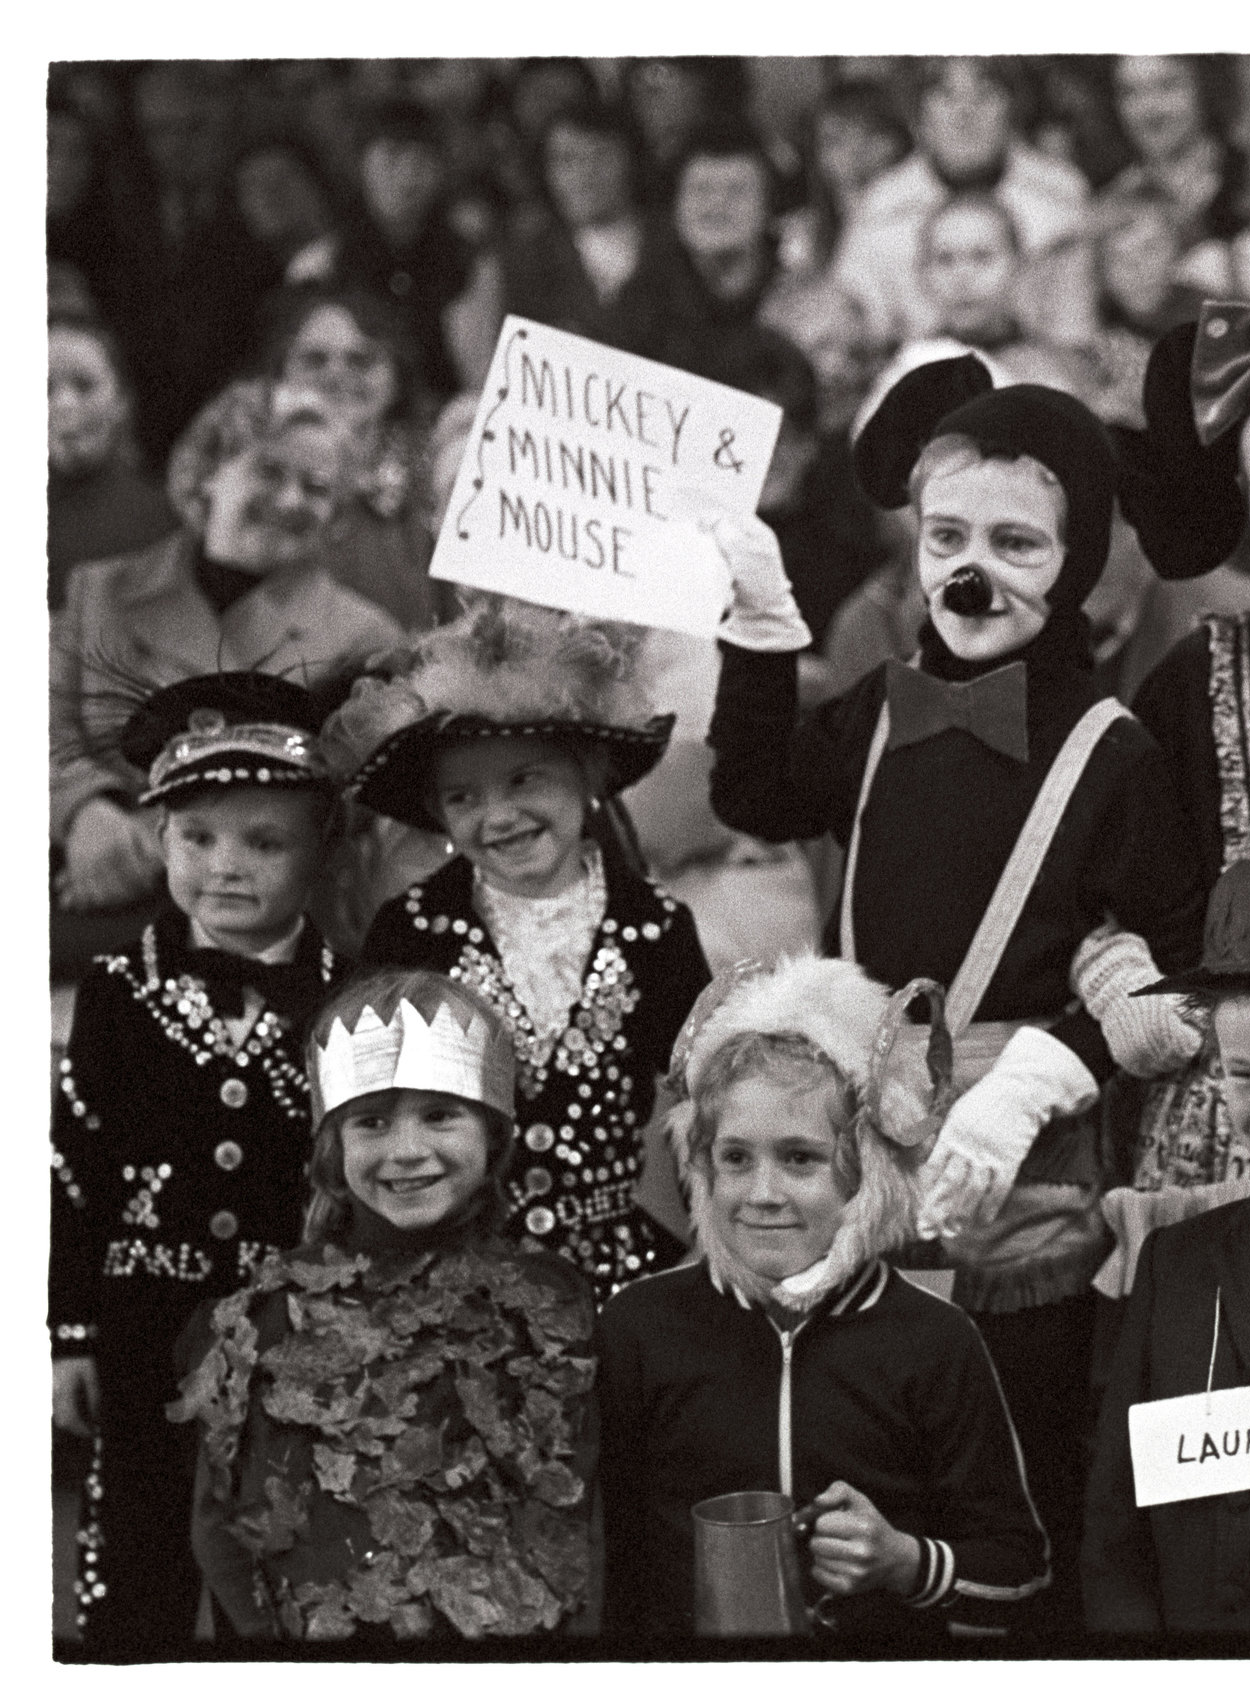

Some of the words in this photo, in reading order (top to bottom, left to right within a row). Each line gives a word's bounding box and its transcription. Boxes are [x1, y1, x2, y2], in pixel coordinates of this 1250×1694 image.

[520, 352, 690, 465] MICKEY
[712, 427, 745, 474] &
[507, 424, 668, 522] MINNIE
[499, 488, 636, 579] MOUSE
